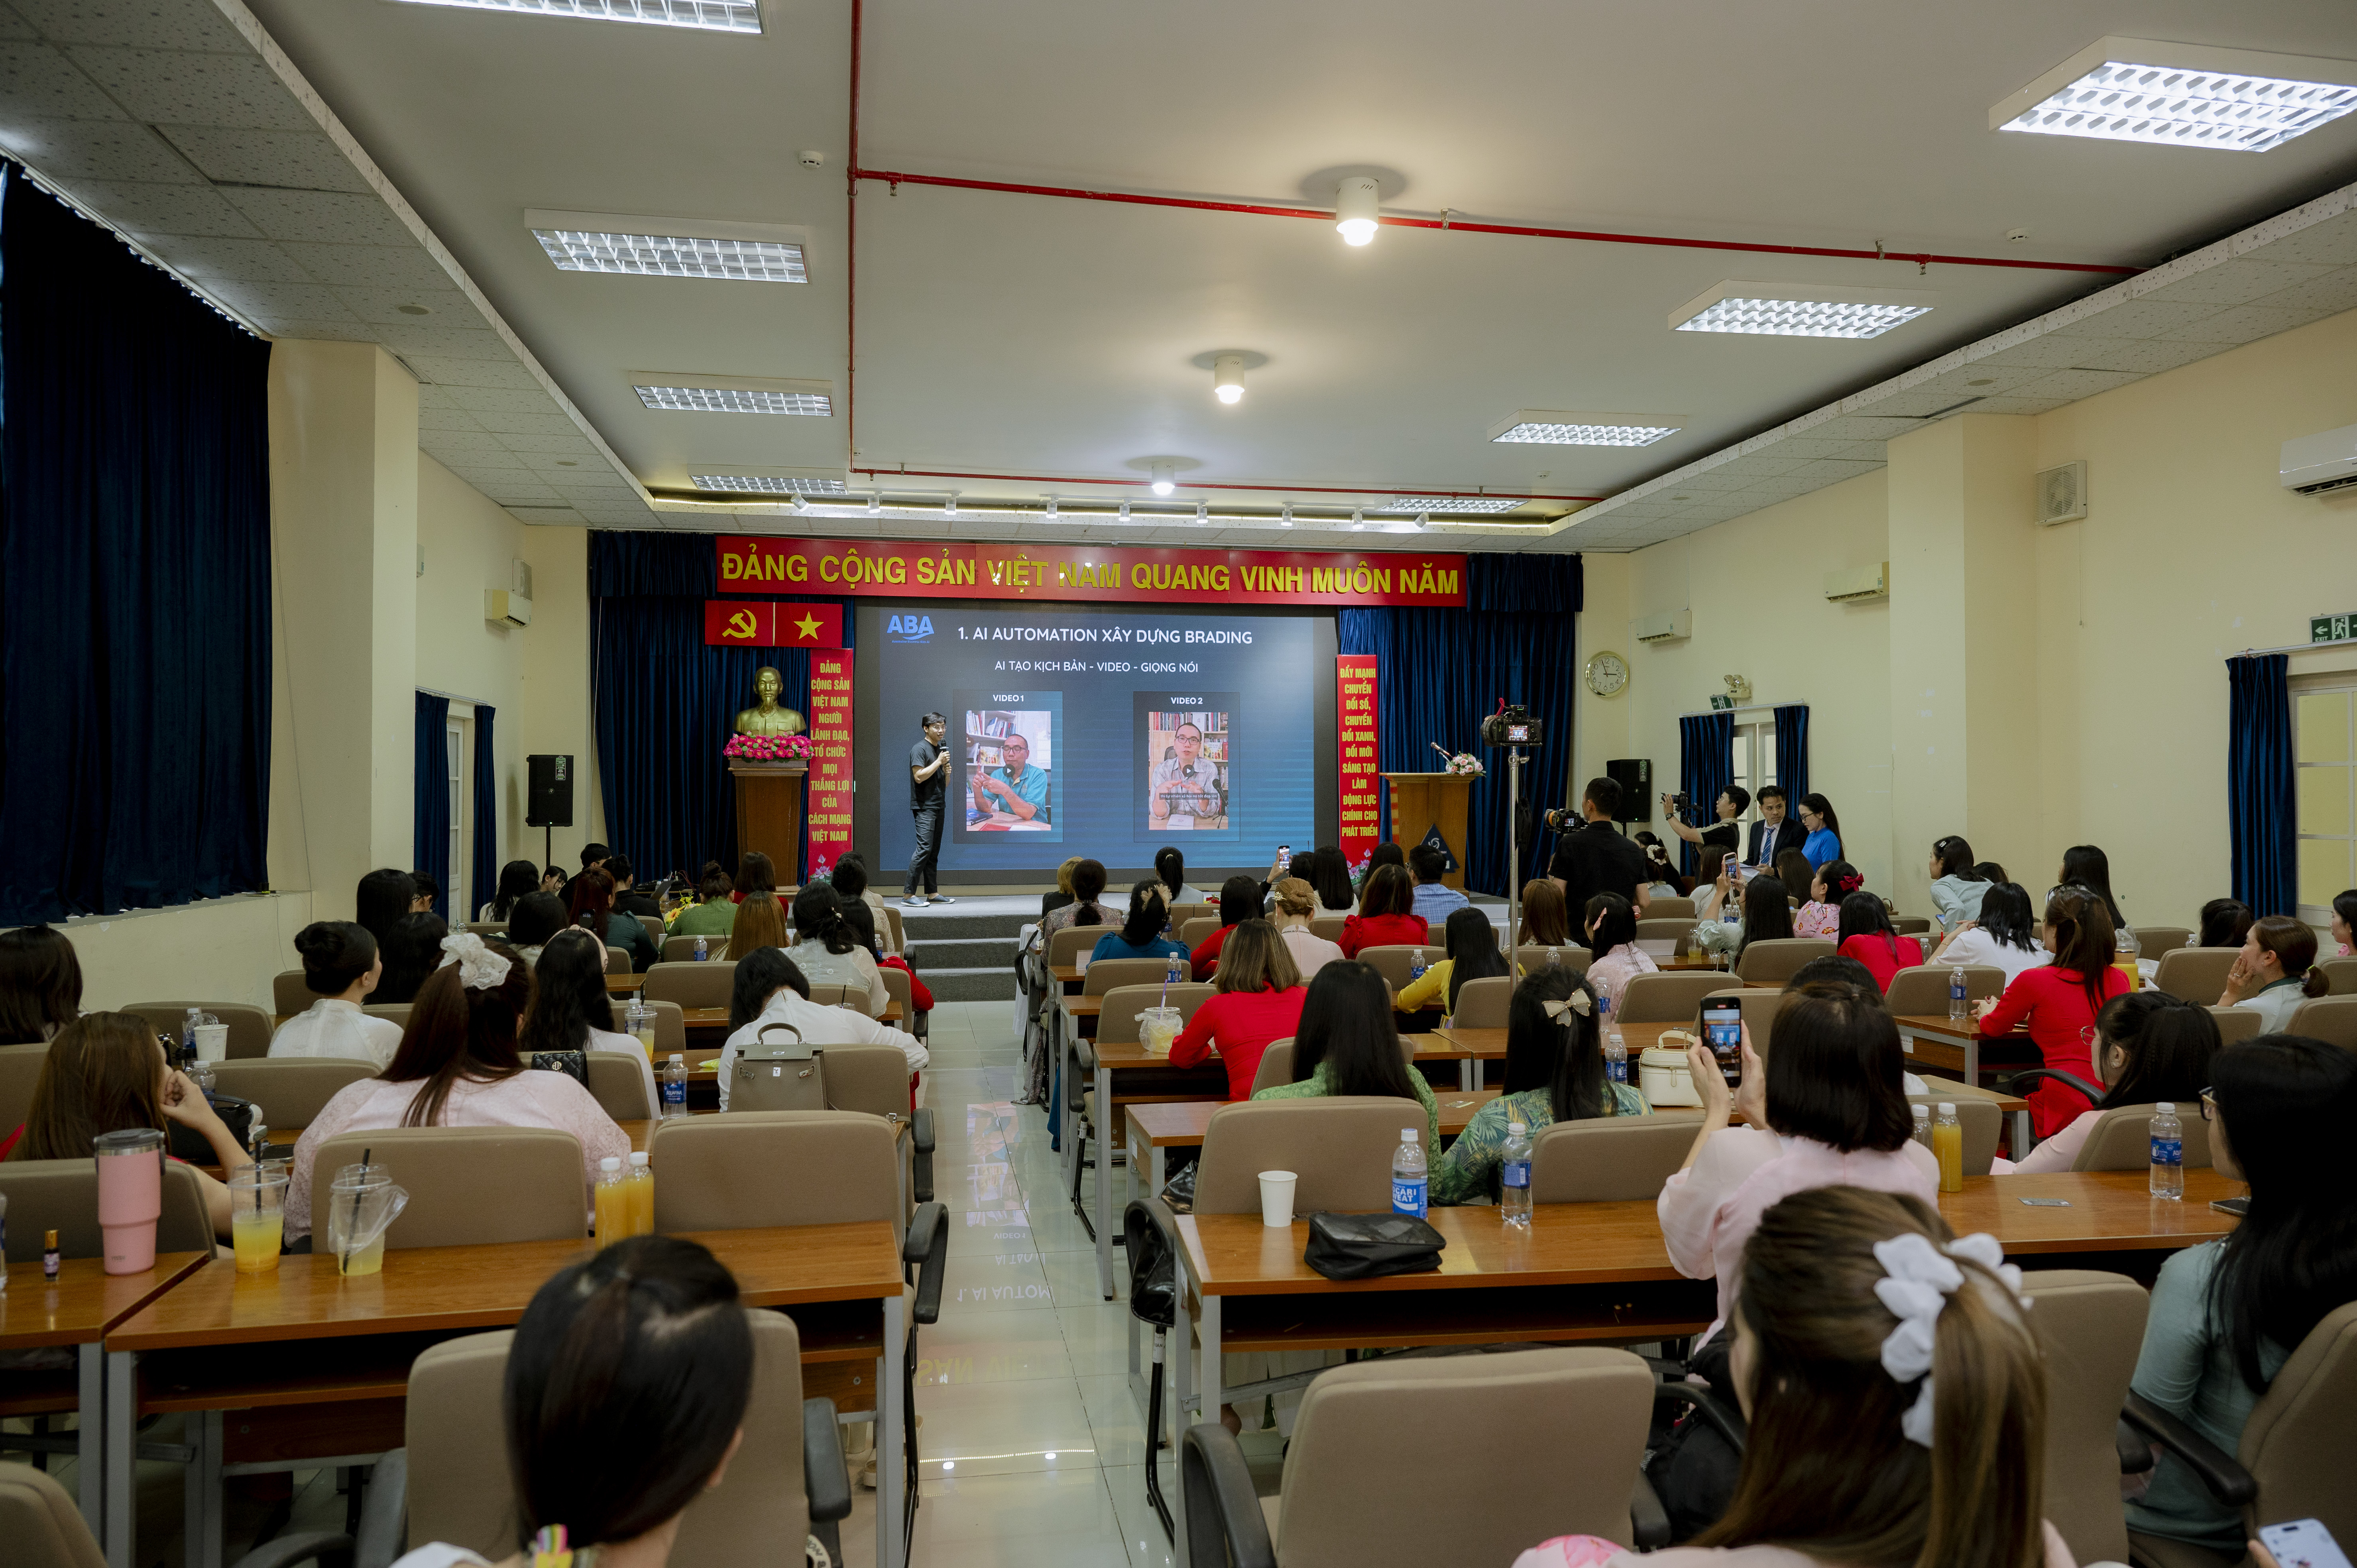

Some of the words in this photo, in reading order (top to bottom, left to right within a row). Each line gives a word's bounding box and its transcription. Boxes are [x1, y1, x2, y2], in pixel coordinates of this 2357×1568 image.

[723, 544, 808, 582] ĐẢNG
[820, 548, 906, 589] CỘNG
[917, 548, 975, 586] SẢN
[987, 553, 1048, 593] VIỆT
[1059, 562, 1120, 589] NAM
[1131, 563, 1230, 591] QUANG
[1240, 566, 1303, 592] VINH
[1312, 560, 1391, 593] MUÔN
[1400, 562, 1458, 594] NĂM
[887, 615, 934, 635] ABA
[958, 627, 969, 640] 1.
[973, 627, 987, 640] AI
[993, 628, 1097, 642] AUTOMATION
[1102, 626, 1132, 642] XÂY
[1137, 629, 1180, 645] DỰNG
[1185, 631, 1252, 644] BRADING
[820, 660, 841, 673] ĐẢNG
[995, 661, 1005, 670] AI
[1009, 661, 1031, 672] TẠO
[1035, 661, 1060, 672] KỊCH
[1064, 659, 1086, 671] BẢN
[1097, 662, 1130, 672] VIDEO
[1141, 663, 1176, 674] GIỌNG
[1179, 661, 1198, 672] NÓI
[1340, 664, 1353, 678] ĐẨY
[1355, 668, 1376, 680] MẠNH
[811, 678, 832, 692] CỘNG
[834, 677, 849, 690] SẢN
[1345, 680, 1372, 694] CHUYỂN
[813, 694, 828, 709] VIỆT
[831, 697, 848, 707] NAM
[1346, 696, 1358, 710] ĐỔI
[1359, 697, 1371, 711] SỐ,
[818, 711, 842, 724] NGƯỜI
[1345, 712, 1372, 726] CHUYỂN
[811, 729, 830, 740] LÃNH
[833, 730, 850, 743] ĐẠO,
[1342, 728, 1354, 741] ĐỔI
[1355, 731, 1376, 742] XANH,
[814, 743, 824, 757] TỔ
[826, 745, 846, 757] CHỨC
[1346, 744, 1357, 757] ĐỔI
[1359, 745, 1373, 757] MỚI
[823, 764, 837, 776] MỌI
[1343, 761, 1361, 773] SÁNG
[1363, 763, 1376, 775] TẠO
[811, 777, 835, 791] THẮNG
[837, 780, 849, 793] LỢI
[1352, 777, 1367, 789] LÀM
[822, 794, 837, 808] CỦA
[1343, 793, 1362, 807] ĐỘNG
[1364, 794, 1376, 806] LỰC
[808, 812, 828, 825] CÁCH
[830, 814, 851, 826] MẠNG
[1342, 809, 1362, 821] CHÍNH
[1364, 811, 1377, 820] CHO
[812, 829, 828, 843] VIỆT
[830, 831, 847, 841] NAM
[1342, 825, 1358, 837] PHÁT
[1360, 823, 1378, 837] TRIỂN
[1392, 1186, 1417, 1196] OCARI
